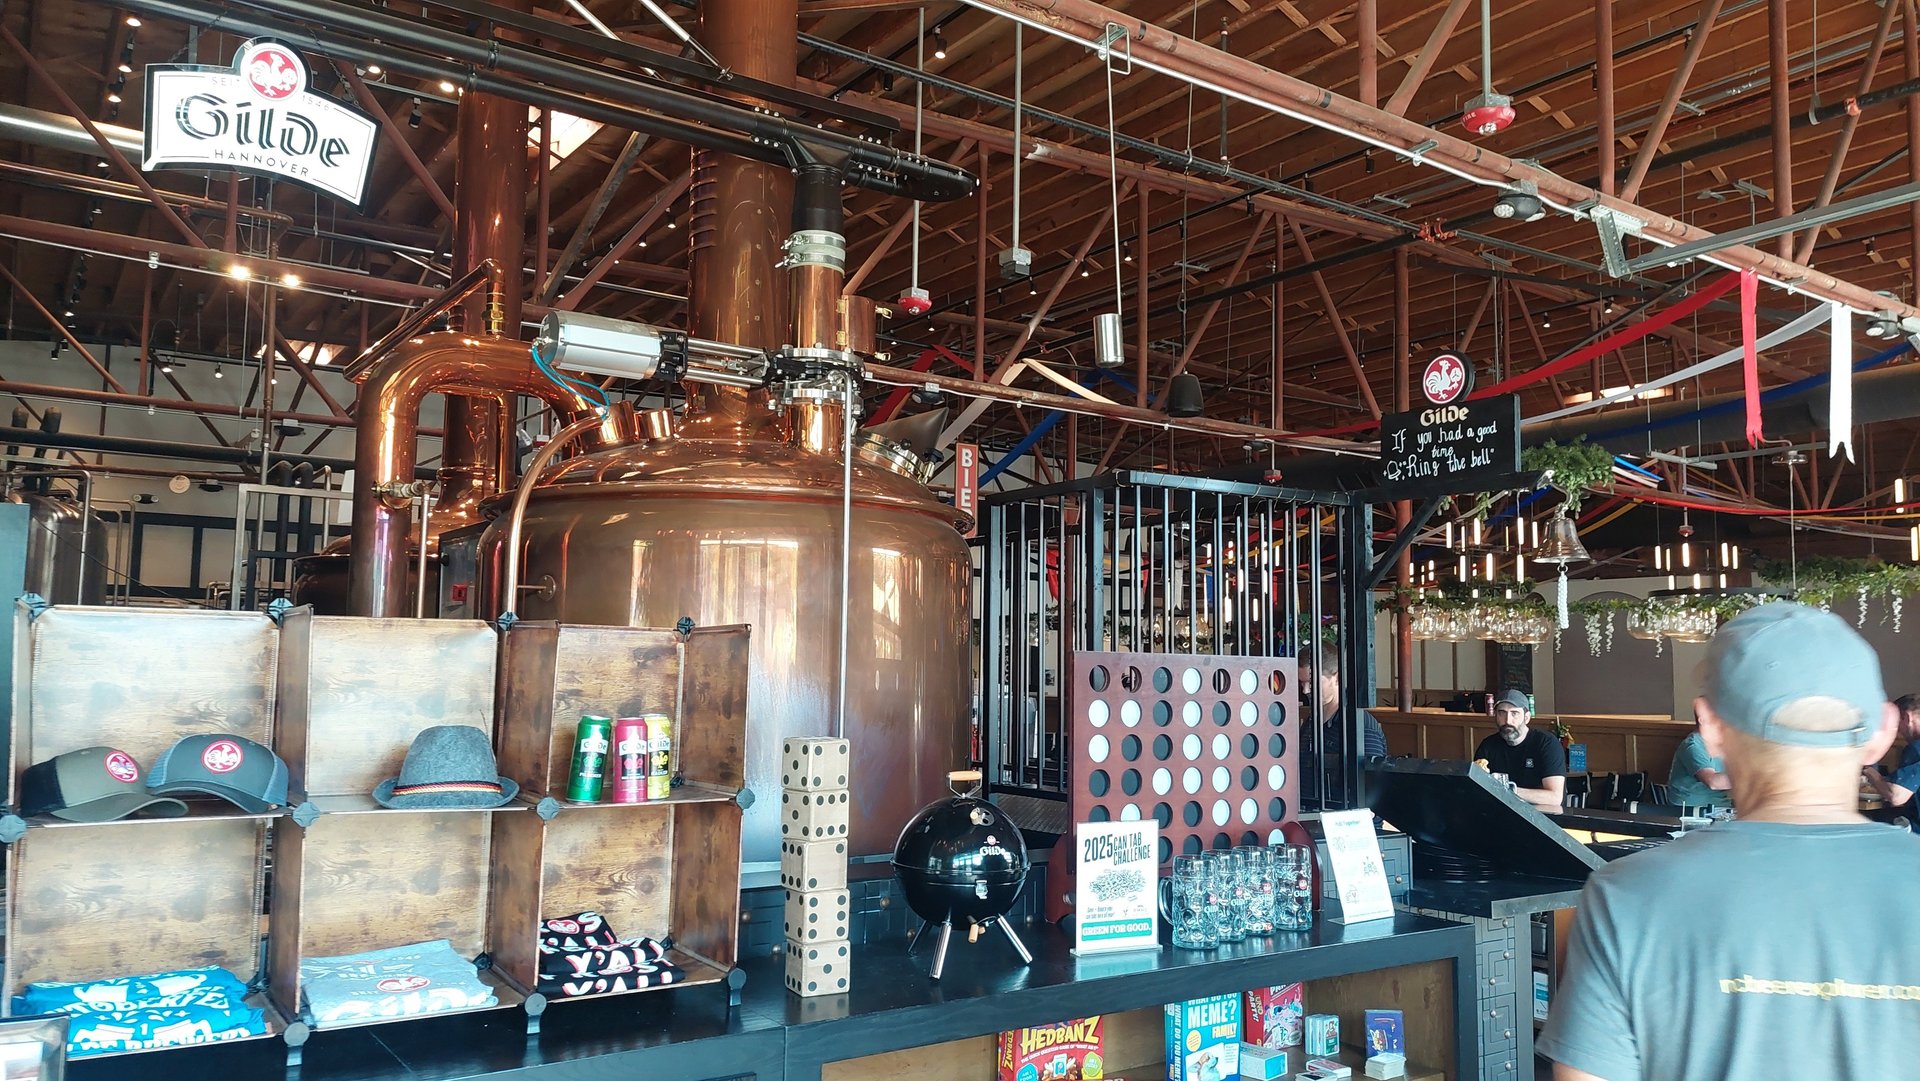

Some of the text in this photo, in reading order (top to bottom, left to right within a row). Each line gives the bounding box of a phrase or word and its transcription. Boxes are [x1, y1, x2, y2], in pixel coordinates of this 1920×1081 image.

[175, 92, 351, 168] Gilde
[214, 148, 310, 177] HANNOVER
[1420, 405, 1470, 427] Gilde
[1417, 430, 1433, 452] you
[1438, 423, 1464, 443] had
[1466, 427, 1475, 438] a
[1475, 420, 1498, 443] good
[1431, 444, 1454, 458] time
[1446, 453, 1466, 473] the
[1084, 833, 1114, 863] 2025
[1113, 831, 1142, 852] CAN TAB
[1113, 843, 1151, 866] CHALLENGE
[1109, 924, 1127, 934] FOR
[1127, 922, 1152, 933] GOOD.
[1187, 999, 1237, 1030] MEME?
[1247, 990, 1259, 1022] PARTY!
[1255, 994, 1264, 1015] UNO
[1020, 1015, 1101, 1056] HEDBANZ
[1174, 1027, 1181, 1040] DO
[1212, 1022, 1238, 1039] FAMILY
[1003, 1030, 1014, 1071] EDBANZ
